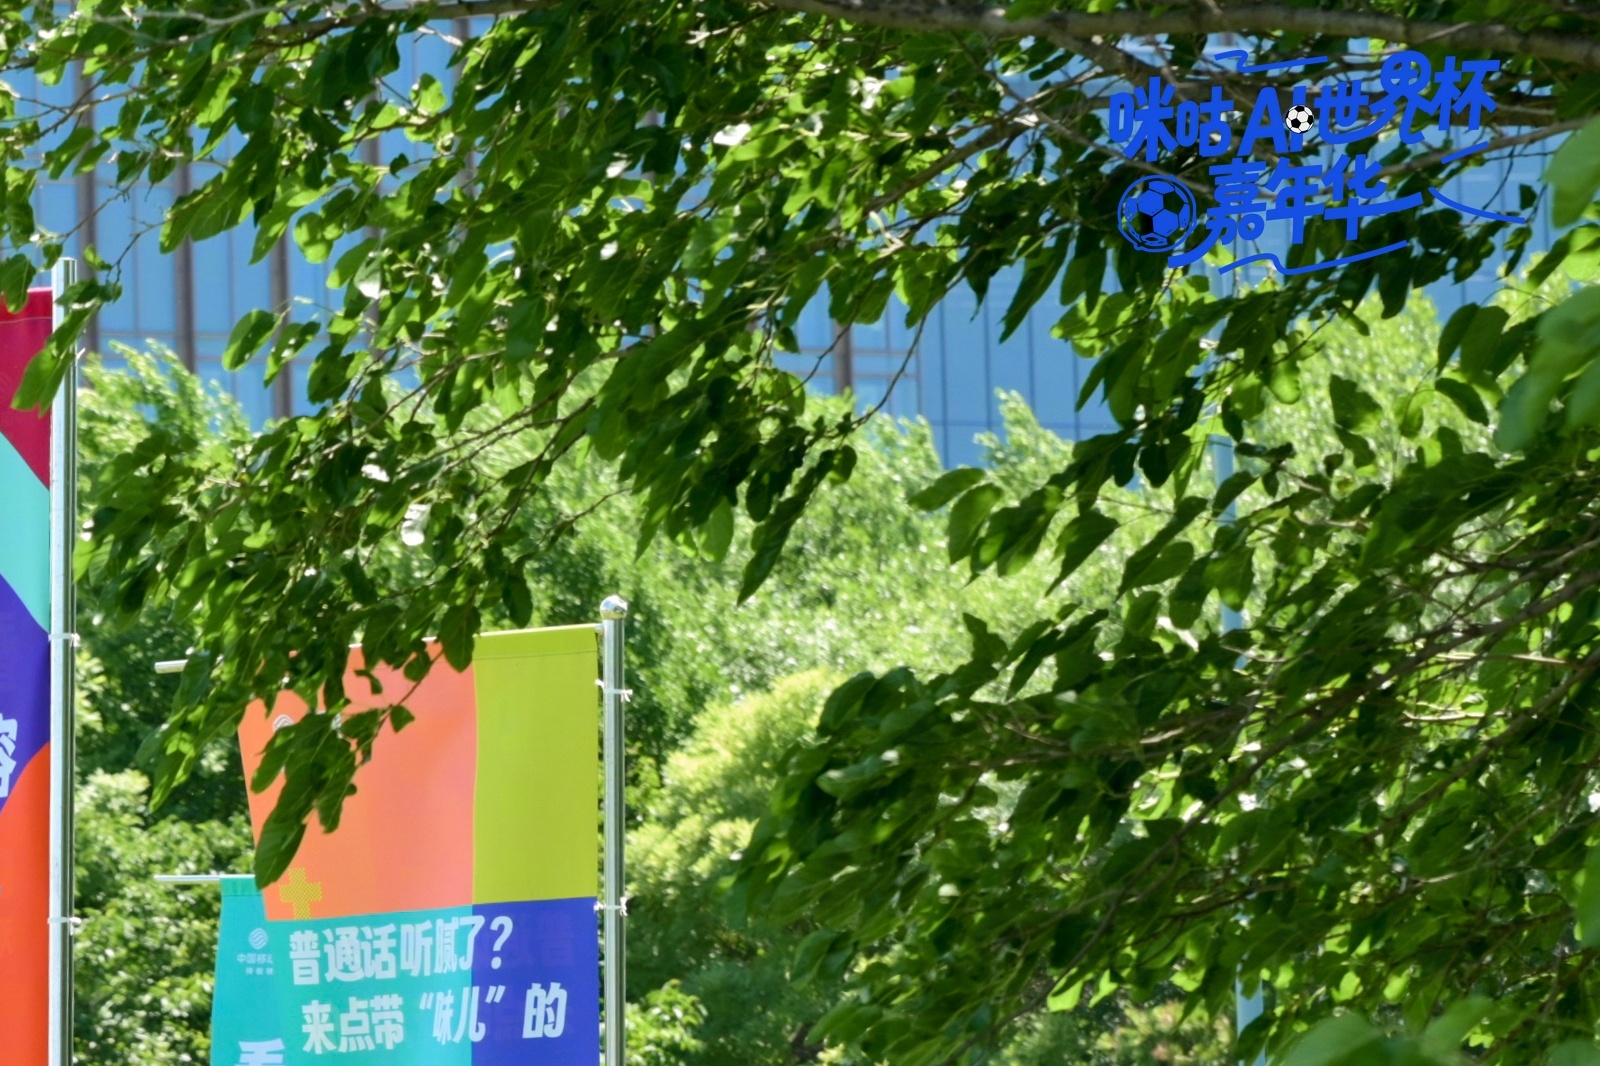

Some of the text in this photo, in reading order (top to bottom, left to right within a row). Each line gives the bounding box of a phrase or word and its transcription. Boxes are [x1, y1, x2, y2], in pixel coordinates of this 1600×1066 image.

[289, 914, 514, 987] 普通话听腻了？
